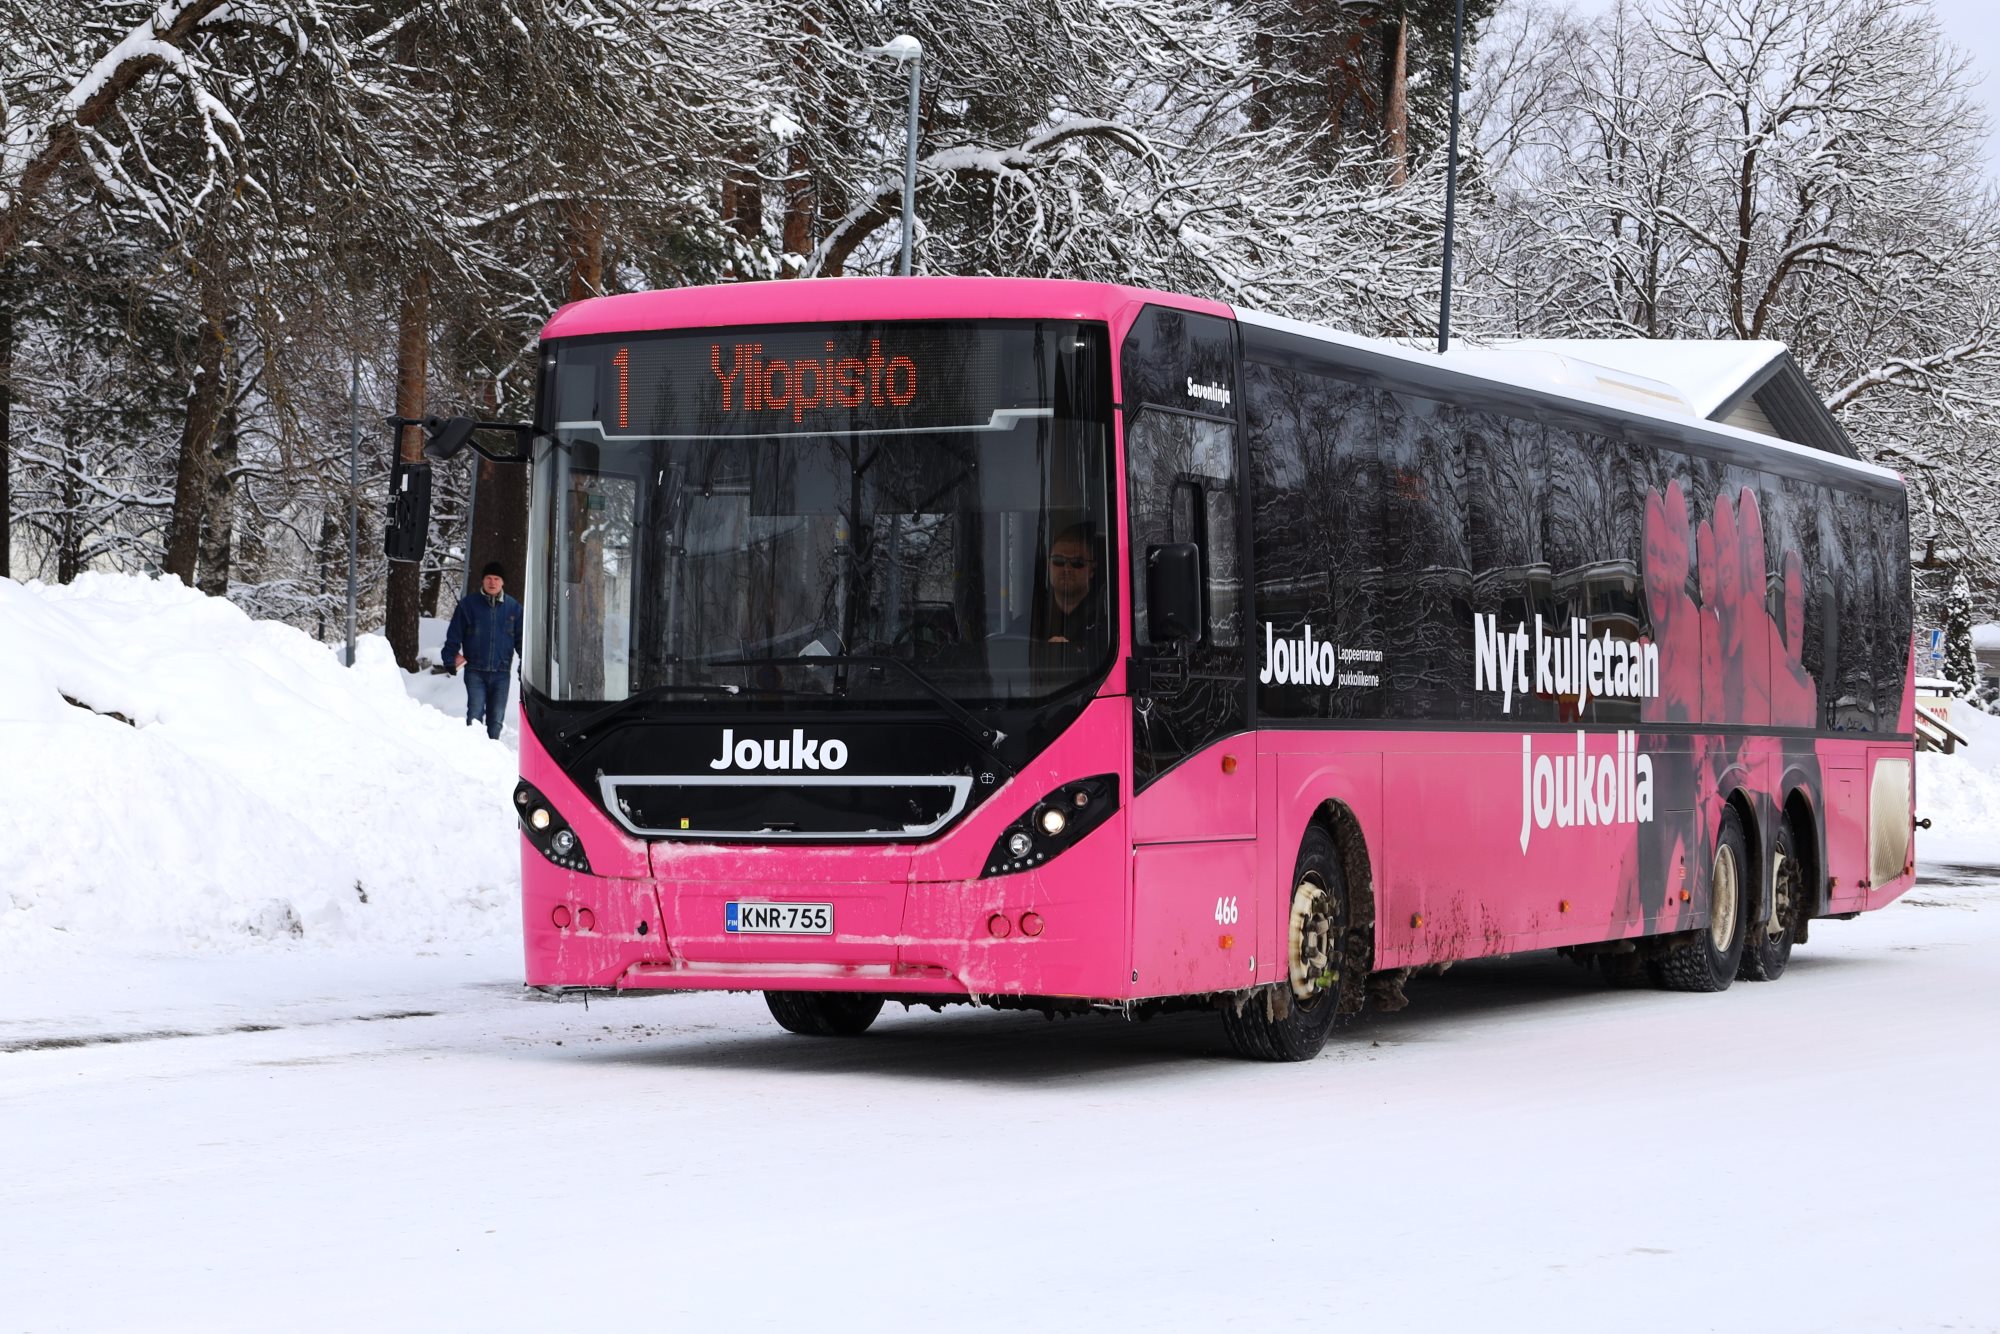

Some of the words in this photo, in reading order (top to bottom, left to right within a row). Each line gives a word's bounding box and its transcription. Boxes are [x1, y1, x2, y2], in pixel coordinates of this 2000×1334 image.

[611, 346, 629, 428] 1
[711, 339, 917, 423] Yliopisto
[1187, 376, 1230, 409] Savonlinja
[1260, 621, 1335, 687] Jouko
[1337, 643, 1383, 664] Lappeenrannan
[1474, 613, 1529, 714] Nyt
[1535, 613, 1659, 717] kuljetaan
[1337, 670, 1380, 690] joukkoliikenne
[709, 728, 848, 770] Jouko
[1519, 729, 1654, 857] Joukolla
[727, 919, 738, 927] FIN
[1214, 895, 1239, 926] 466
